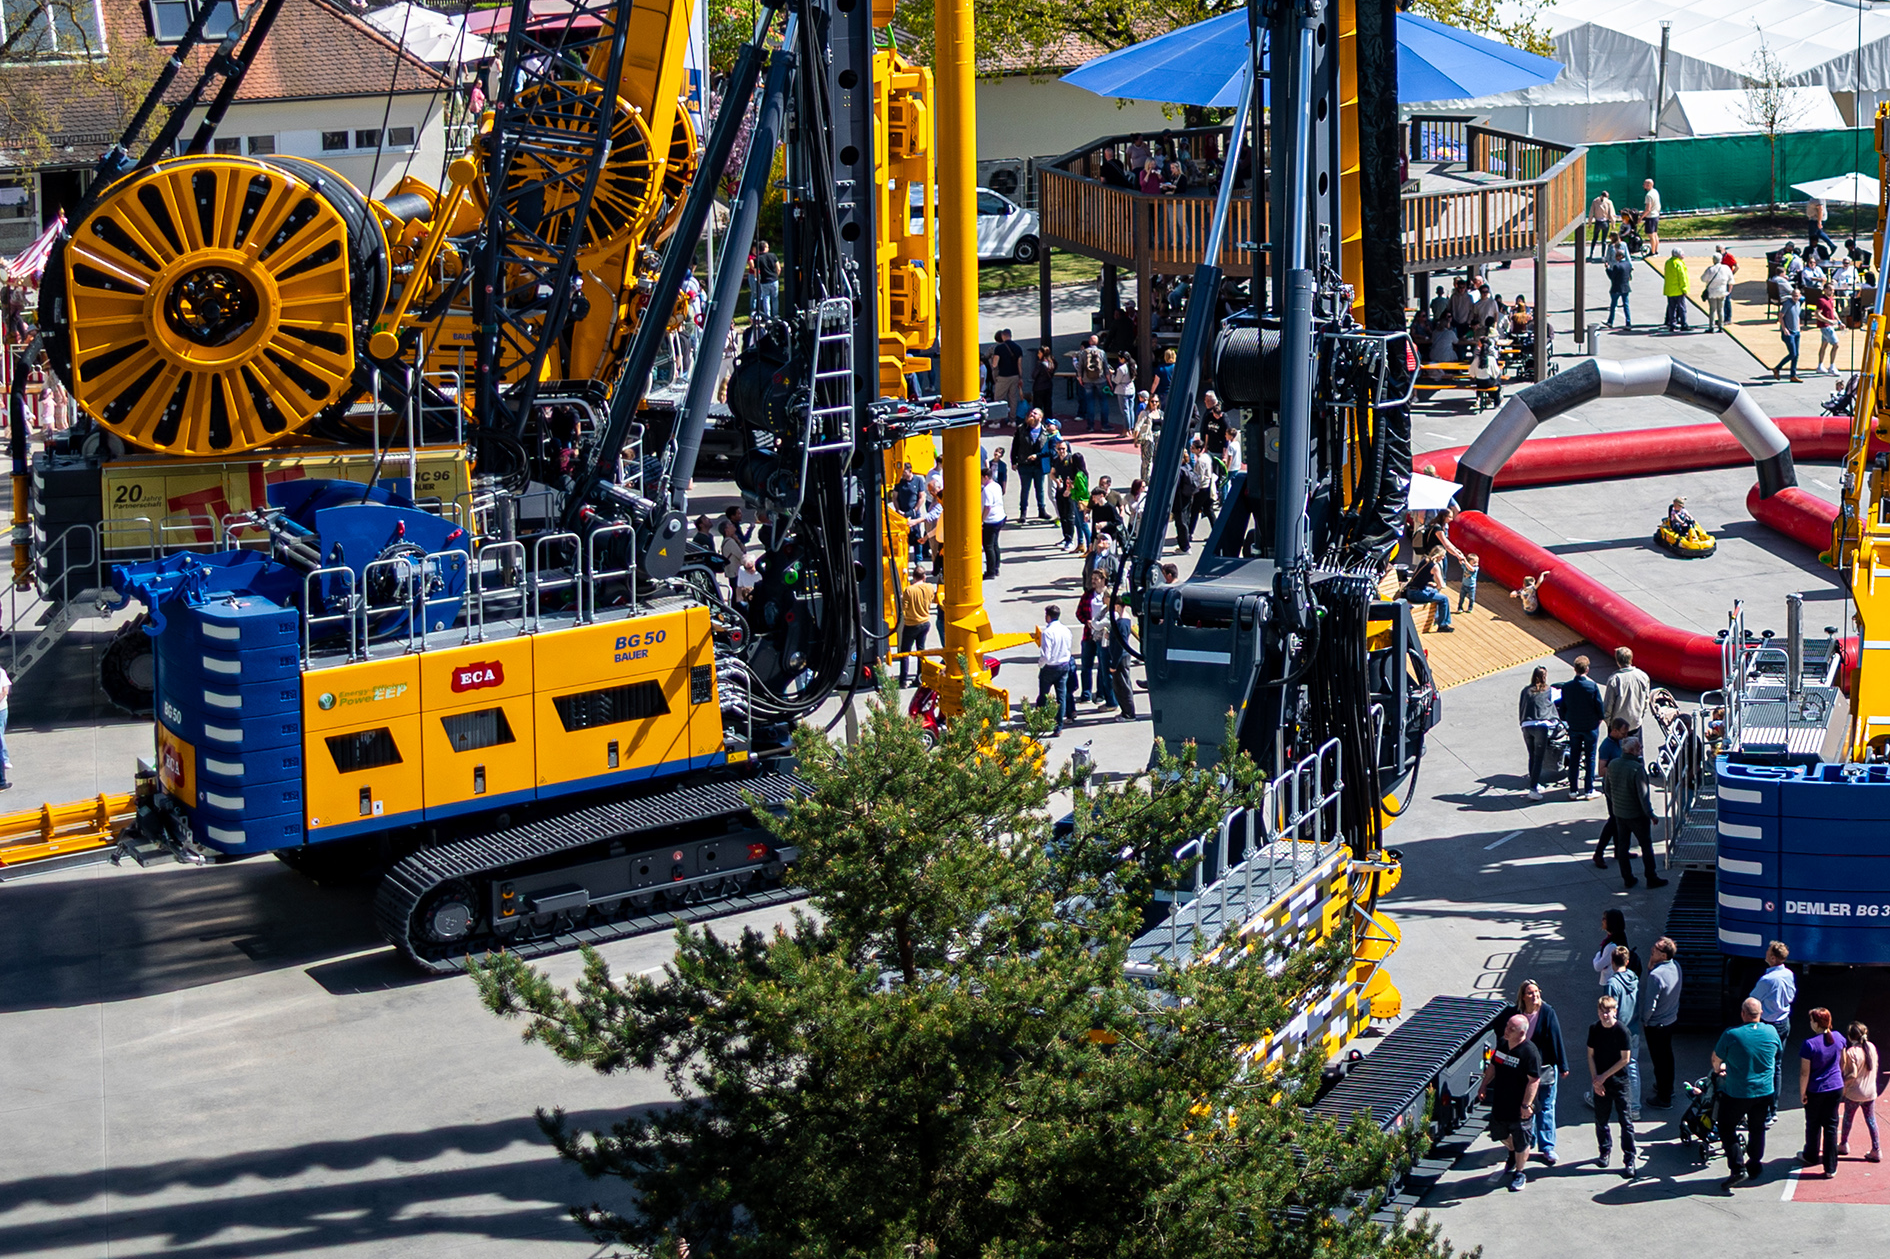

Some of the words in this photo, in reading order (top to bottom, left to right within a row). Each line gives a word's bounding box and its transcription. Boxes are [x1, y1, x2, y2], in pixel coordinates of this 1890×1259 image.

[433, 470, 450, 481] 96
[115, 484, 143, 503] 20
[113, 501, 162, 509] Partnerschaft
[614, 635, 641, 651] BG
[644, 629, 666, 646] 50
[614, 649, 649, 663] BAUER
[460, 668, 495, 685] ECA
[374, 685, 407, 701] EEP
[164, 700, 173, 719] BG
[172, 708, 182, 724] 50
[1785, 900, 1851, 916] DEMLER
[1856, 904, 1879, 916] BG
